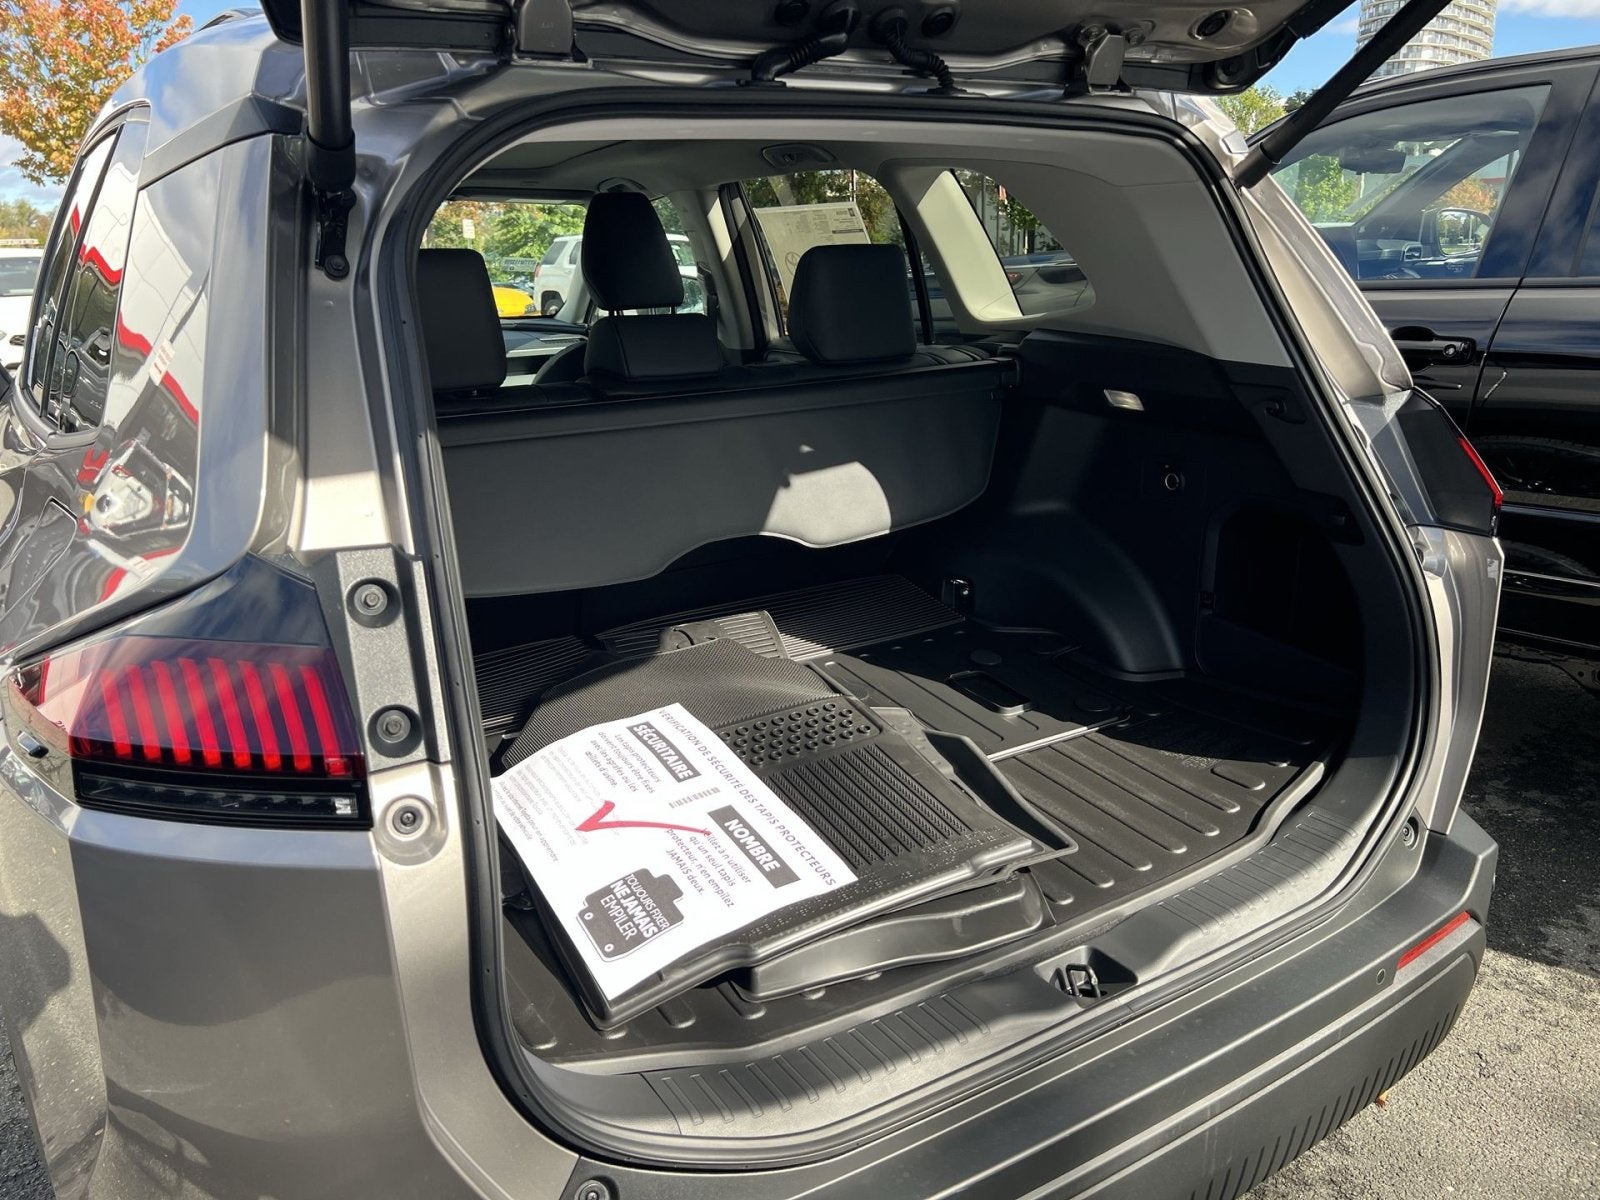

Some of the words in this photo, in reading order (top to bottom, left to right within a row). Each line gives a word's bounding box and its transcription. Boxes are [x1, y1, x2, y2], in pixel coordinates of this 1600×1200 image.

[606, 757, 625, 776] agrafes
[622, 776, 631, 784] ou
[628, 782, 639, 792] les
[613, 748, 635, 770] toujours
[614, 734, 624, 743] Les
[631, 752, 661, 783] protecteurs
[633, 724, 694, 780] SÉCURITAIRE
[697, 745, 712, 757] DE
[707, 756, 745, 790] SÉCURITÉ
[739, 788, 758, 804] DES
[754, 803, 780, 825] TAPIS
[775, 824, 837, 886] PROTECTEURS
[665, 849, 692, 875] JAMAIS
[689, 836, 709, 854] qu'un
[705, 851, 722, 870] seul
[718, 867, 737, 887] tapis
[724, 818, 781, 872] NOMBRE
[610, 879, 631, 899] NE
[695, 863, 712, 879] n'en
[708, 878, 735, 908] empilez
[723, 853, 752, 884] n'utiliser
[600, 893, 638, 941] EMPILER
[619, 895, 659, 938] JAMAIS
[624, 873, 657, 911] TOUJOURS
[649, 907, 671, 931] FIXER
